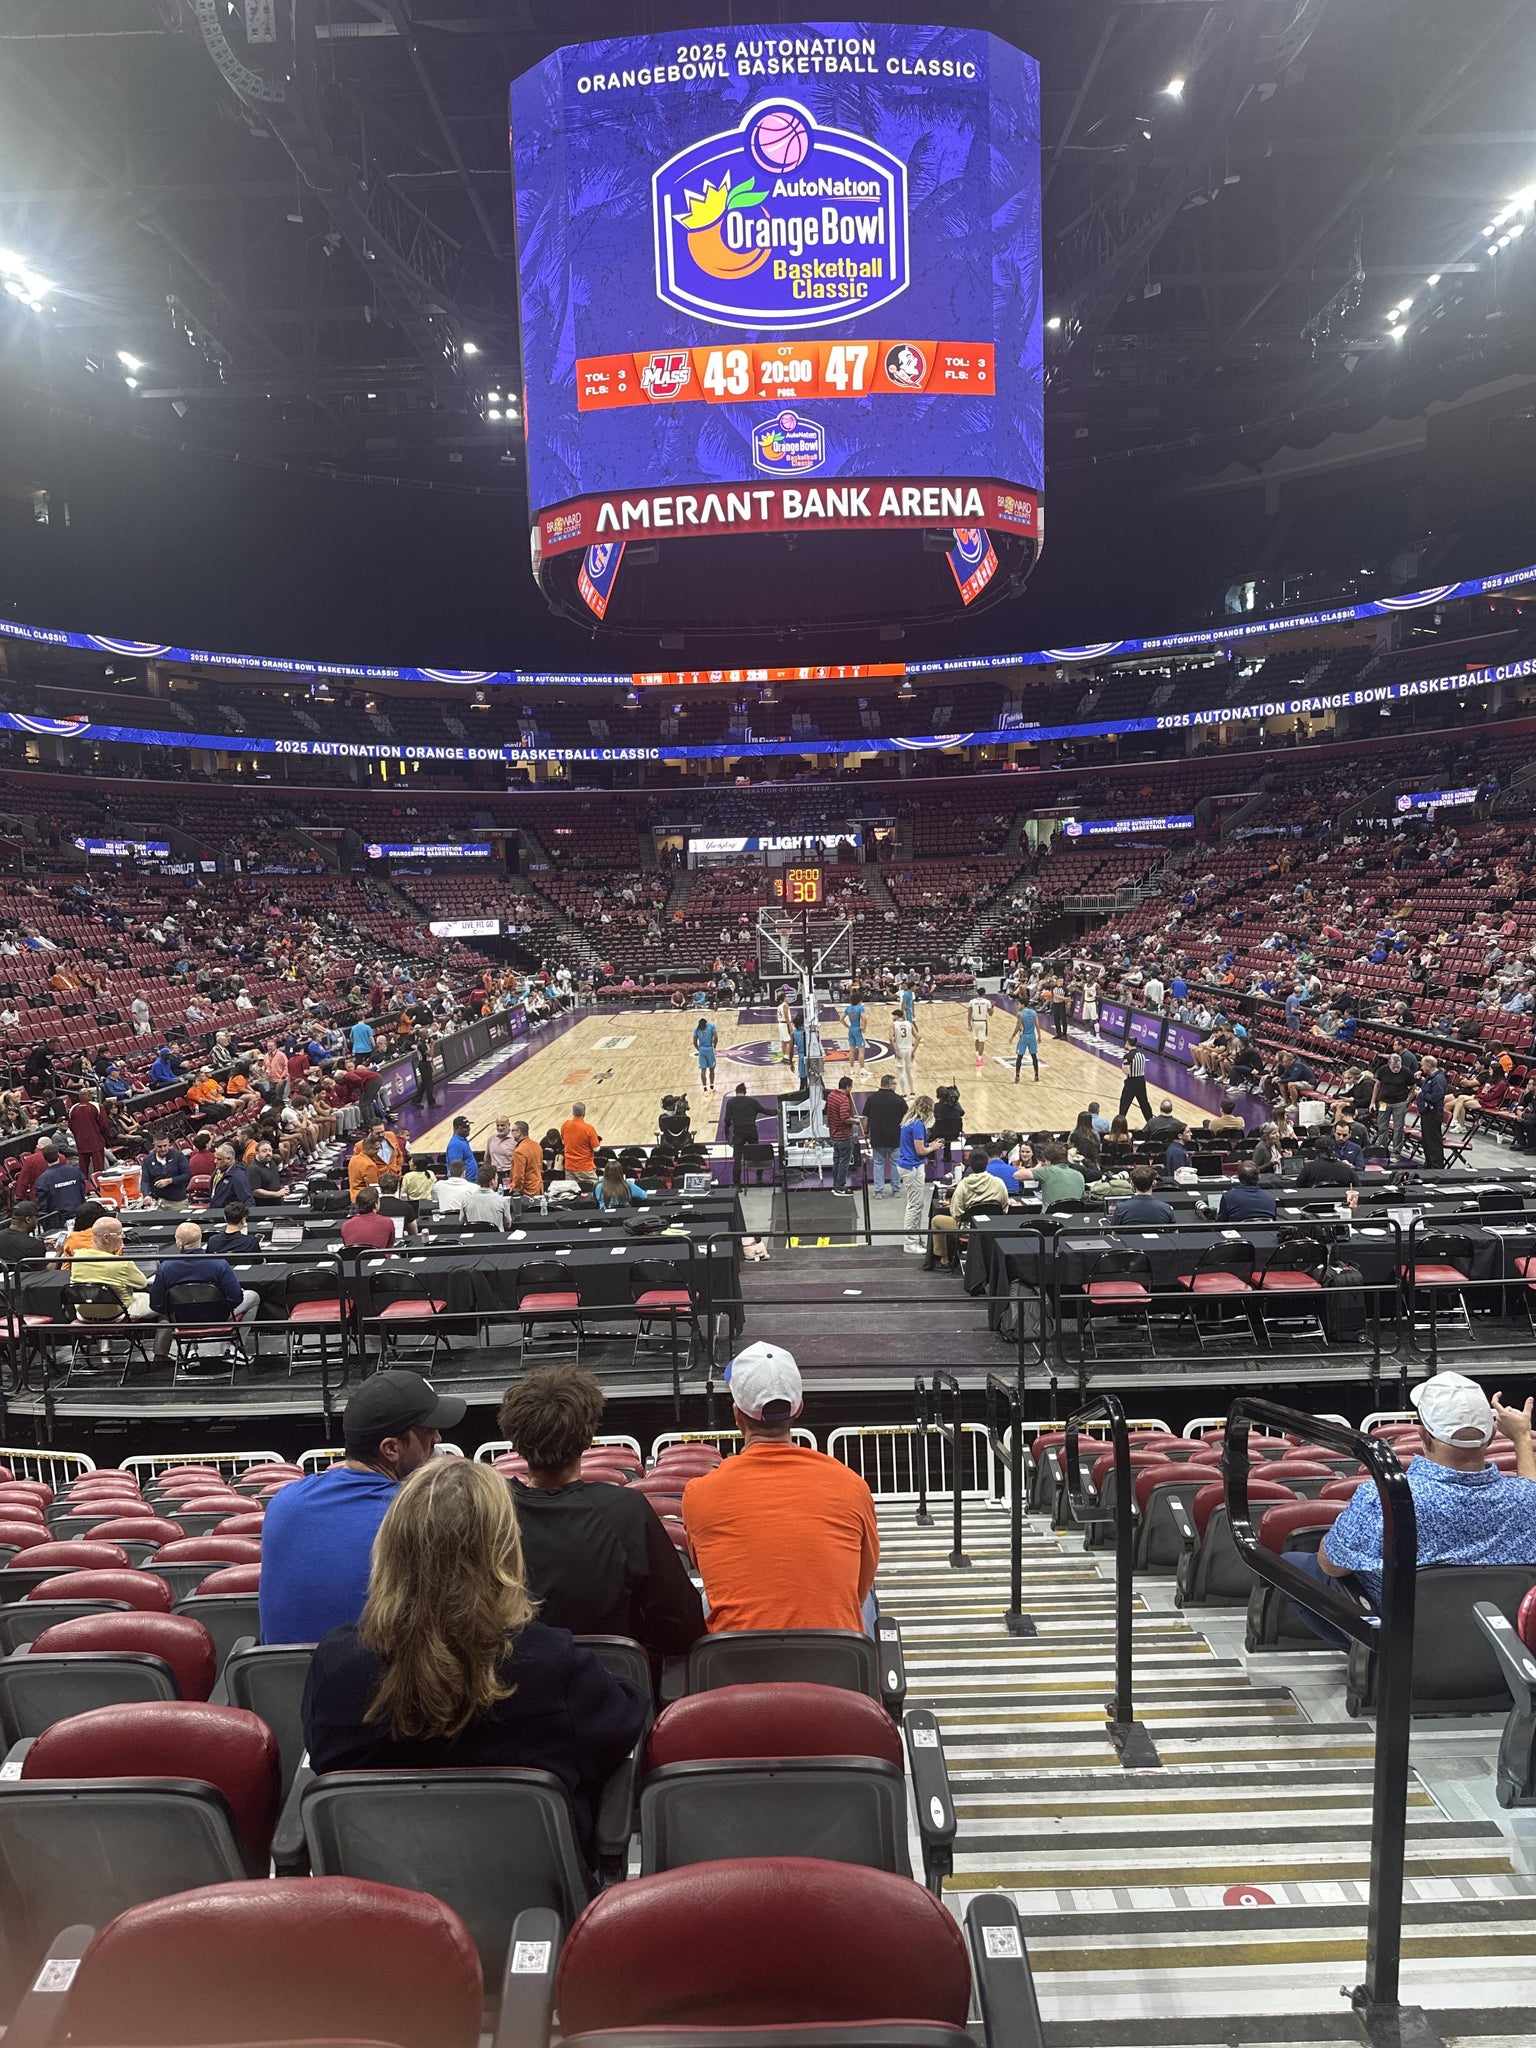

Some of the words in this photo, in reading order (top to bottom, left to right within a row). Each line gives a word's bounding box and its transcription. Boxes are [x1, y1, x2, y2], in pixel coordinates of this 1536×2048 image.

[677, 43, 726, 63] 2025
[735, 39, 876, 58] AUTONATION
[577, 62, 729, 93] ORANGEBOWL
[739, 57, 878, 76] BASKETBALL
[886, 58, 976, 79] CLASSIC
[772, 177, 881, 198] AutoNation
[727, 211, 818, 256] Orange
[822, 207, 884, 245] Bowl
[774, 258, 882, 279] Basketball
[793, 279, 868, 299] Classic
[778, 347, 794, 356] OT
[761, 360, 812, 383] 20:00
[825, 346, 868, 390] 47
[945, 358, 969, 367] TOL:
[978, 359, 986, 367] 3
[585, 373, 610, 382] TOL:
[618, 370, 626, 379] 3
[704, 350, 749, 396] 43
[945, 371, 969, 380] FLS:
[978, 372, 986, 380] 0
[586, 386, 609, 396] FLS:
[618, 383, 627, 392] 0
[595, 490, 775, 532] AMERANT
[782, 487, 872, 519] BANK
[879, 487, 985, 517] ARENA
[1482, 579, 1502, 589] 2025
[0, 623, 32, 637] KETBALL
[33, 631, 67, 642] CLASSIC
[1143, 640, 1161, 649] 2025
[1162, 633, 1211, 646] AUTONATION
[1213, 628, 1244, 639] ORANGE
[1245, 624, 1267, 634] BOWL
[1269, 616, 1319, 630] BASKETBALL
[1321, 610, 1355, 622] CLASSIC
[190, 653, 209, 662] 2025
[210, 655, 260, 666] AUTONATION
[262, 659, 293, 669] ORANGE
[295, 663, 316, 672] BOWL
[318, 665, 365, 676] BASKETBALL
[367, 669, 399, 677] CLASSIC
[922, 664, 943, 672] BOWL
[944, 659, 990, 670] BASKETBALL
[992, 656, 1023, 665] CLASSIC
[516, 675, 533, 683] 2025
[535, 675, 581, 683] AUTONATION
[582, 675, 612, 683] ORANGE
[1157, 714, 1190, 729] 2025
[1194, 703, 1285, 724] AUTONATION
[1290, 693, 1350, 713] ORANGE
[1354, 686, 1395, 704] BOWL
[1399, 668, 1492, 697] BASKETBALL
[275, 741, 308, 753] 2025
[312, 743, 400, 757] AUTONATION
[405, 747, 464, 759] ORANGE
[469, 748, 506, 760] BOWL
[511, 749, 598, 760] BASKETBALL
[602, 748, 659, 760] CLASSIC
[1090, 826, 1131, 834] ORANGEBOWL
[759, 836, 815, 850] FLIGHT
[817, 834, 857, 848] ECK
[789, 869, 819, 881] 20:00
[794, 882, 817, 902] 30
[900, 1027, 907, 1038] 3
[54, 1180, 77, 1188] SECURITY
